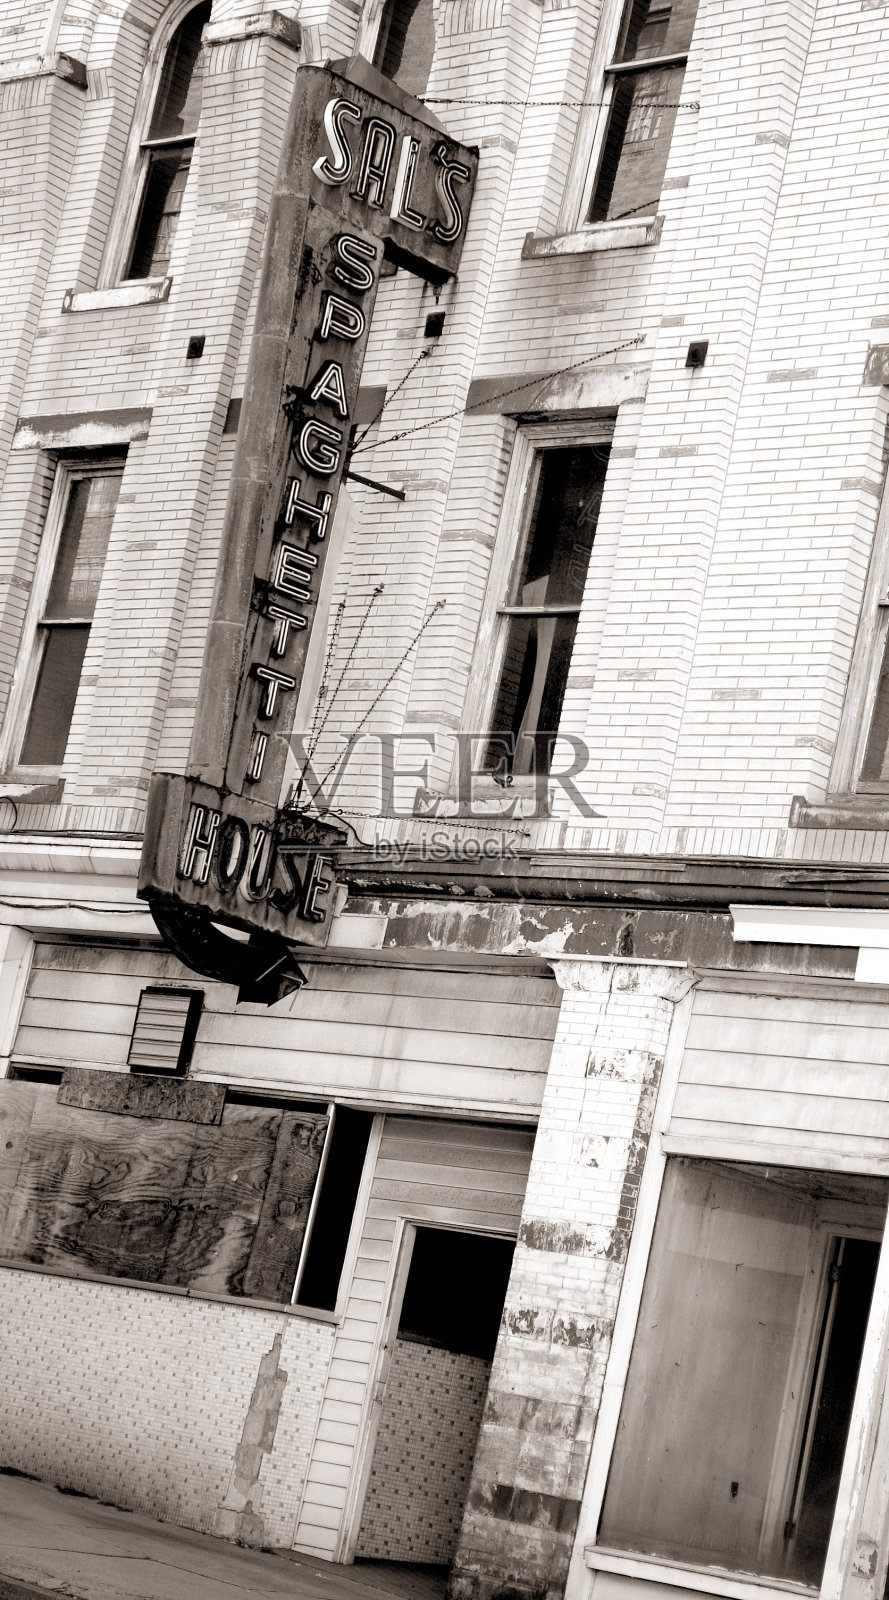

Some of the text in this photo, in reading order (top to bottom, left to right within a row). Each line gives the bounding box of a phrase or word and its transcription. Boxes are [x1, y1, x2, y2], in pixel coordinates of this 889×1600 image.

[312, 98, 471, 243] SAL'S
[249, 232, 378, 783] SPAGHETTI
[179, 804, 335, 922] HOUSE
